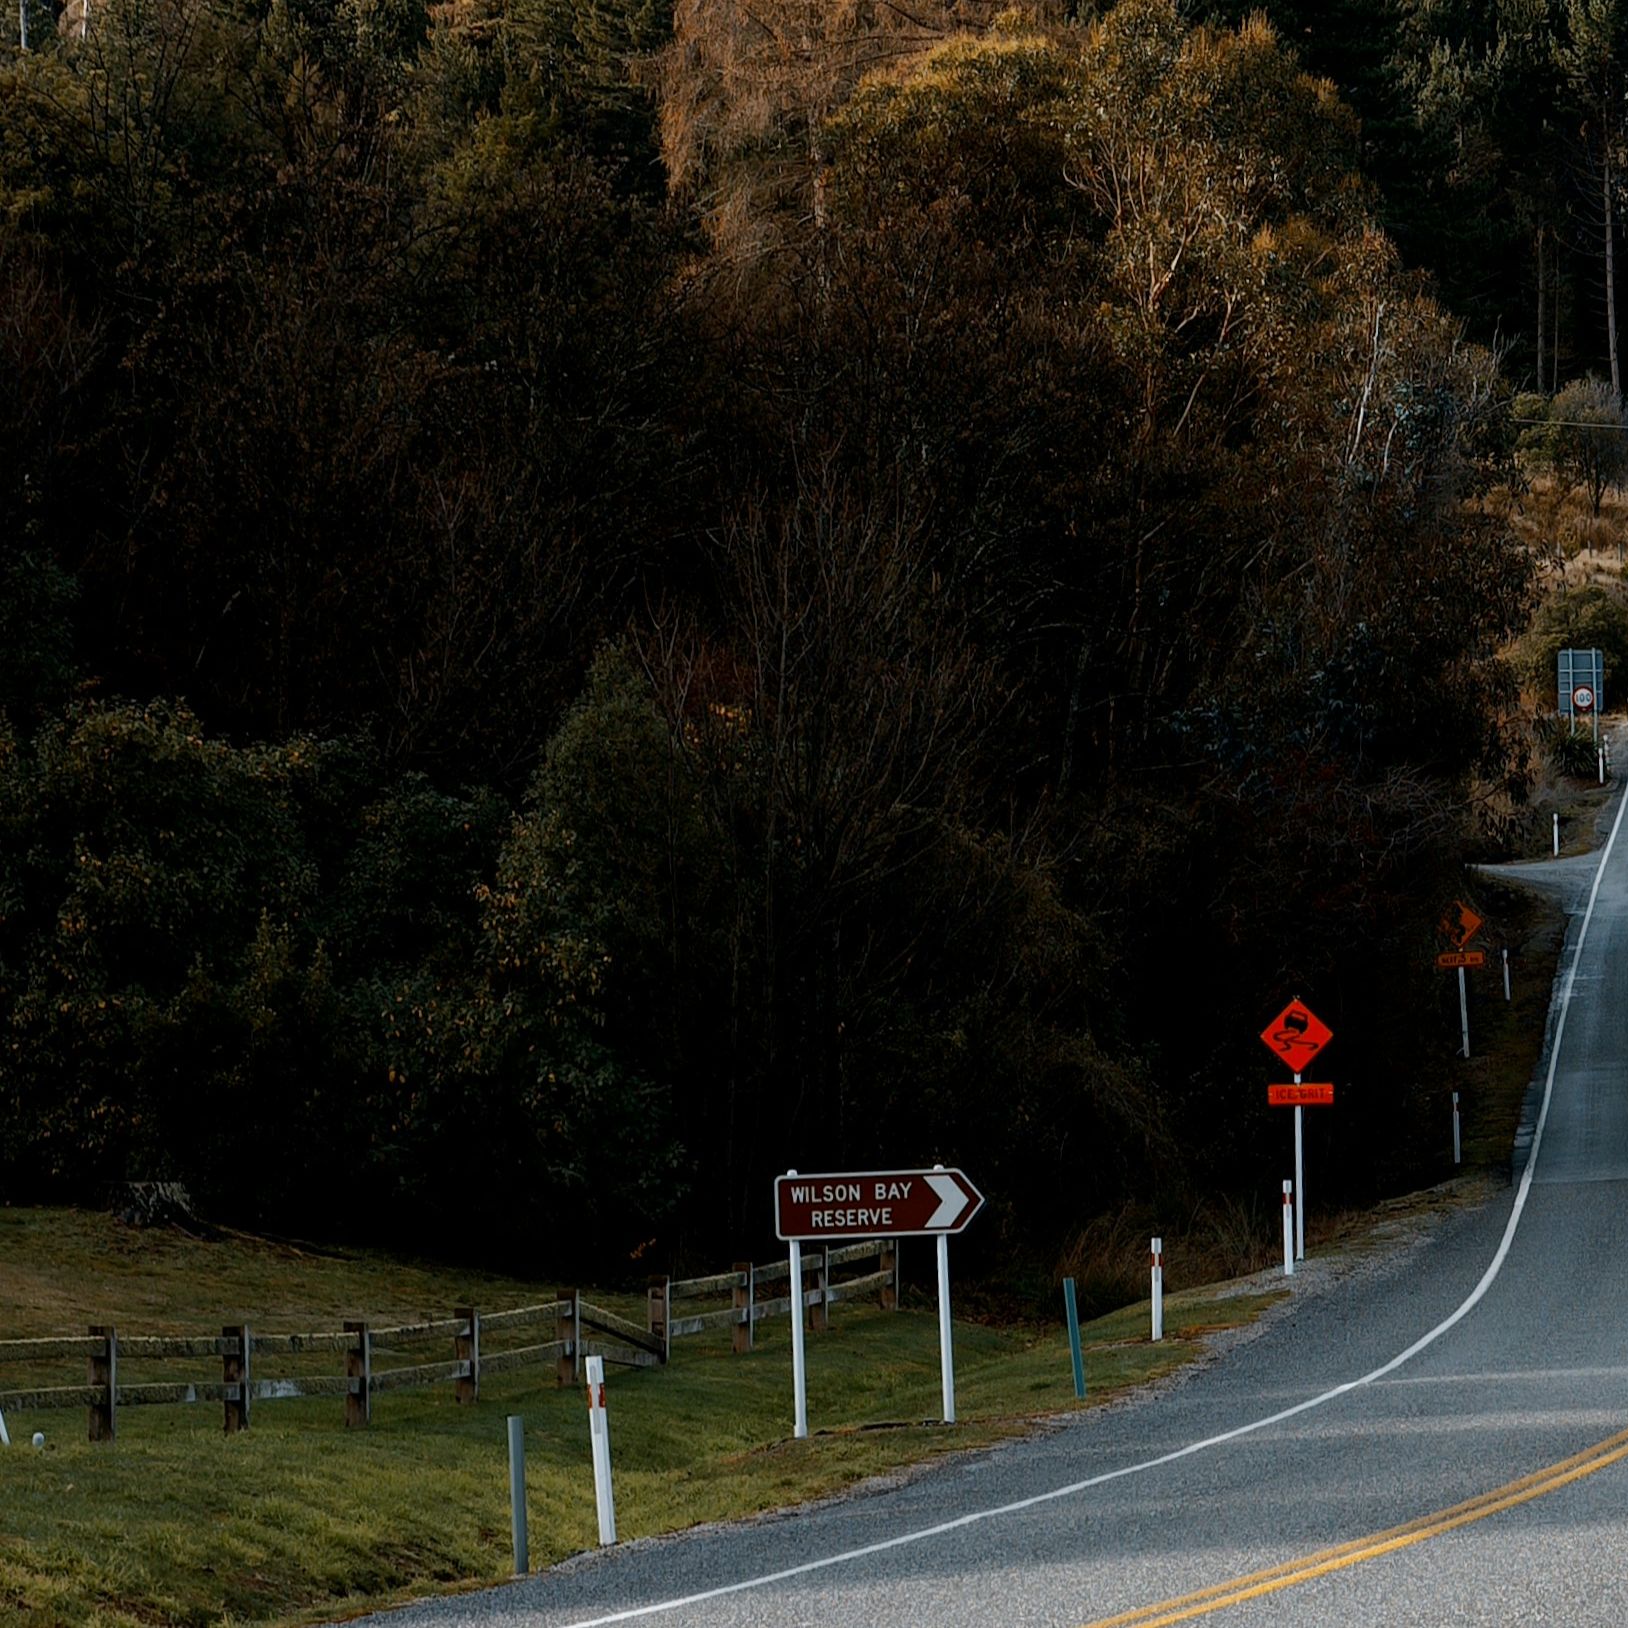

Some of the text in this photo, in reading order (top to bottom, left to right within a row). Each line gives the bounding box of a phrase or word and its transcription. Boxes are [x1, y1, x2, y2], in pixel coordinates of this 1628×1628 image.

[1576, 693, 1592, 703] 100
[791, 1181, 912, 1204] WILSON BAY
[811, 1207, 893, 1228] RESERVE
